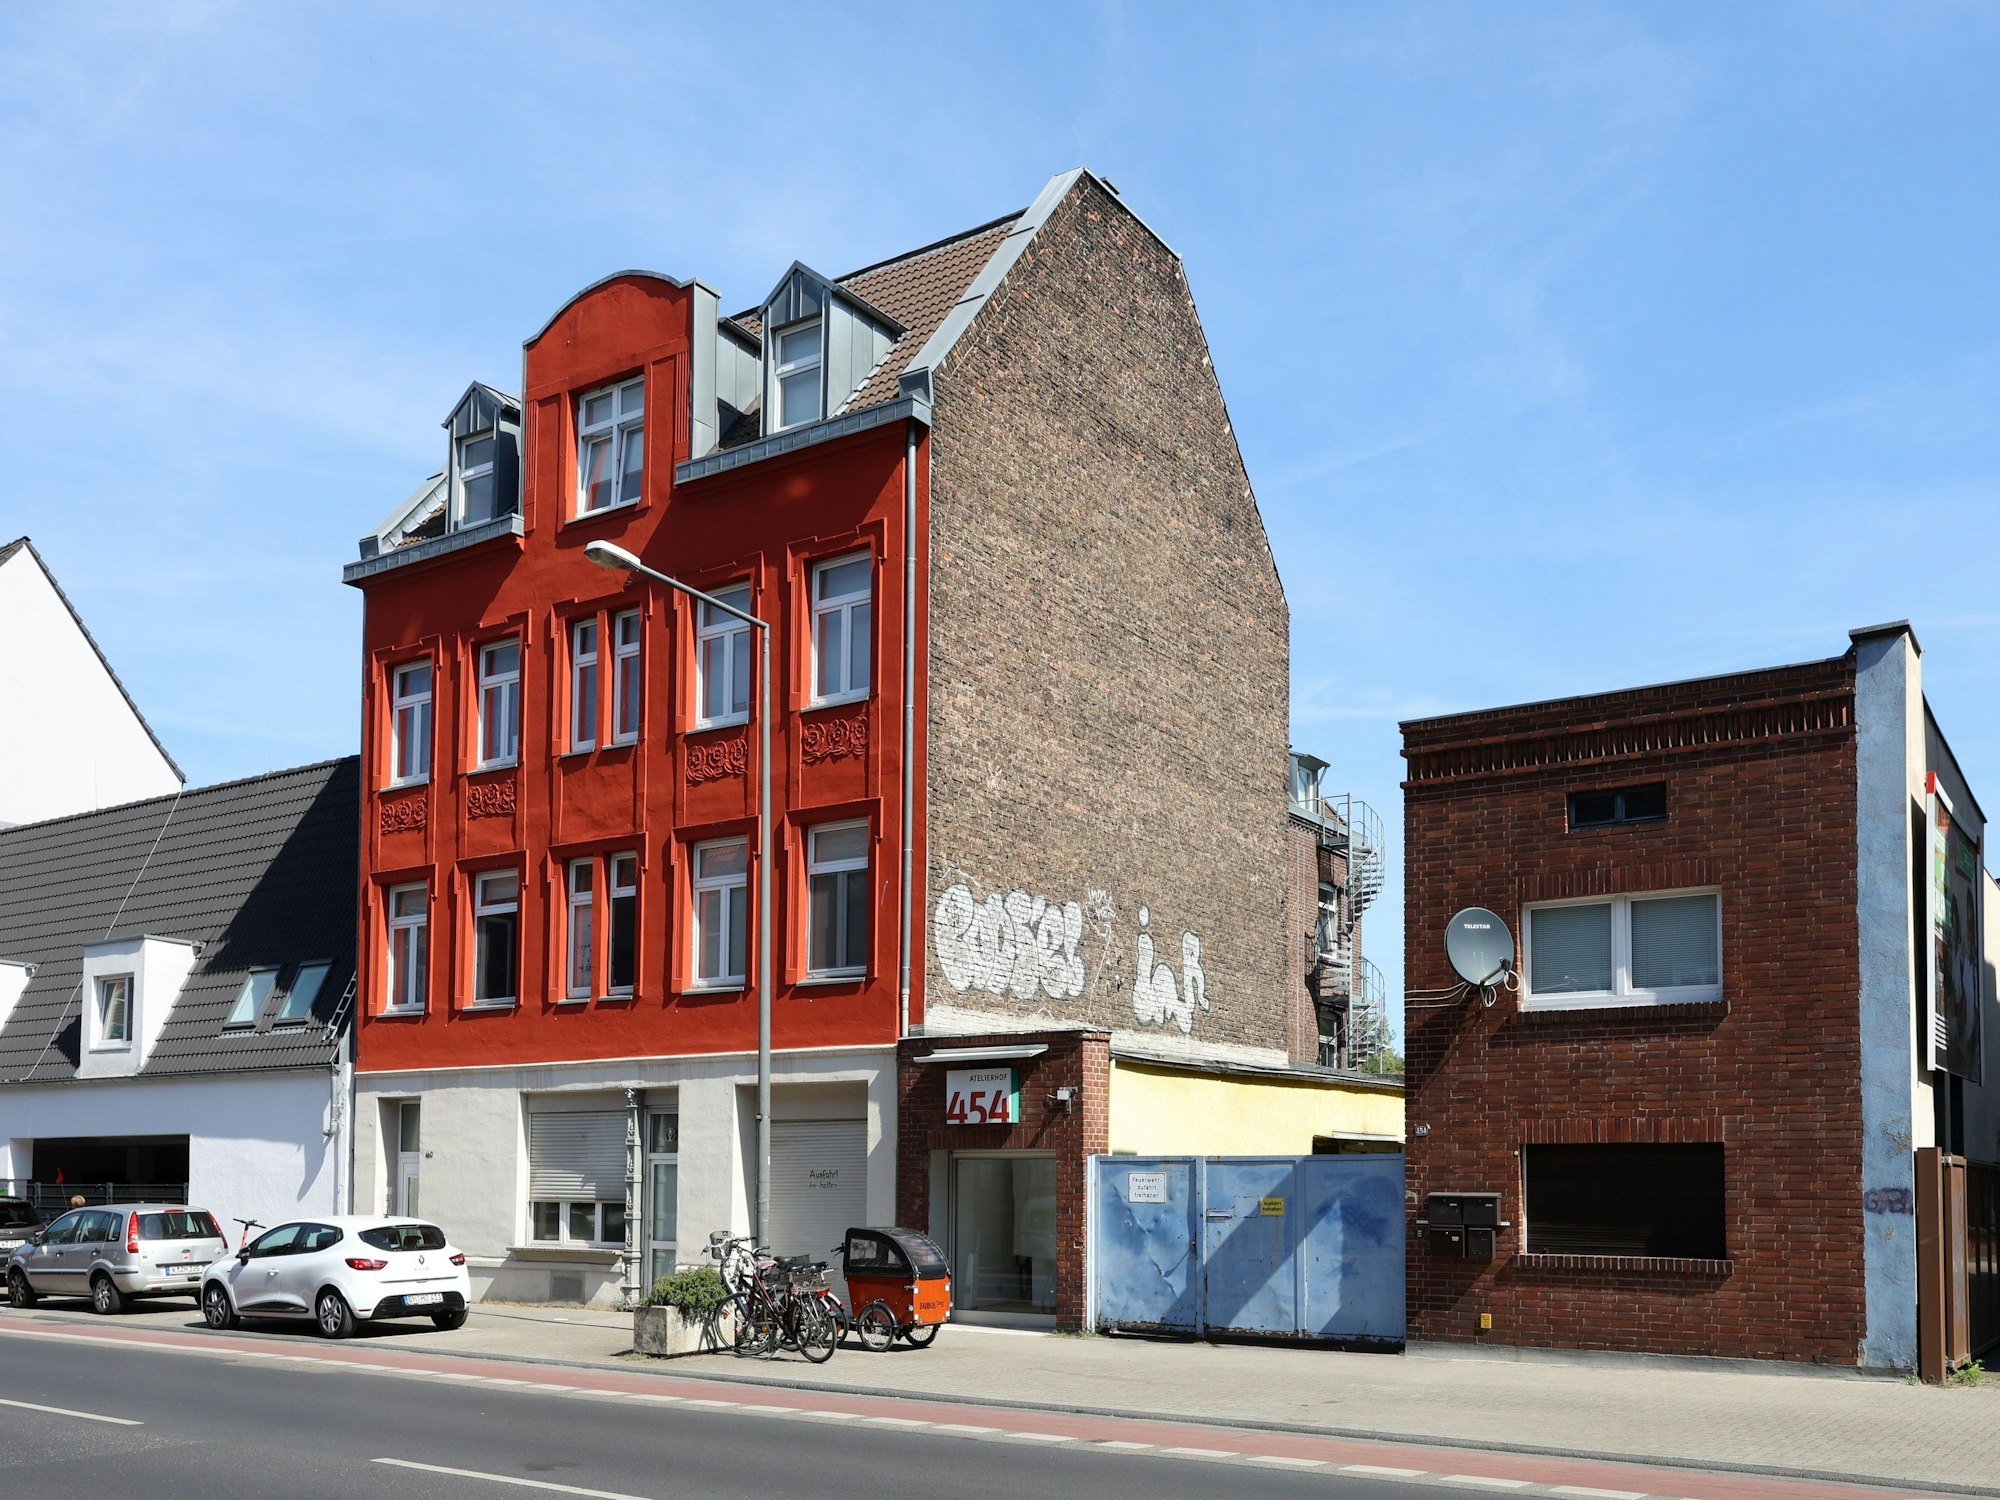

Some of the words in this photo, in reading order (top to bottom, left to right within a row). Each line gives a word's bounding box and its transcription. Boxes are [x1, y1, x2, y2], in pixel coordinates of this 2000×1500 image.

[969, 1073, 1008, 1082] ATELIERHOF
[946, 1089, 1010, 1124] 454
[809, 1169, 839, 1180] Ausfahrt
